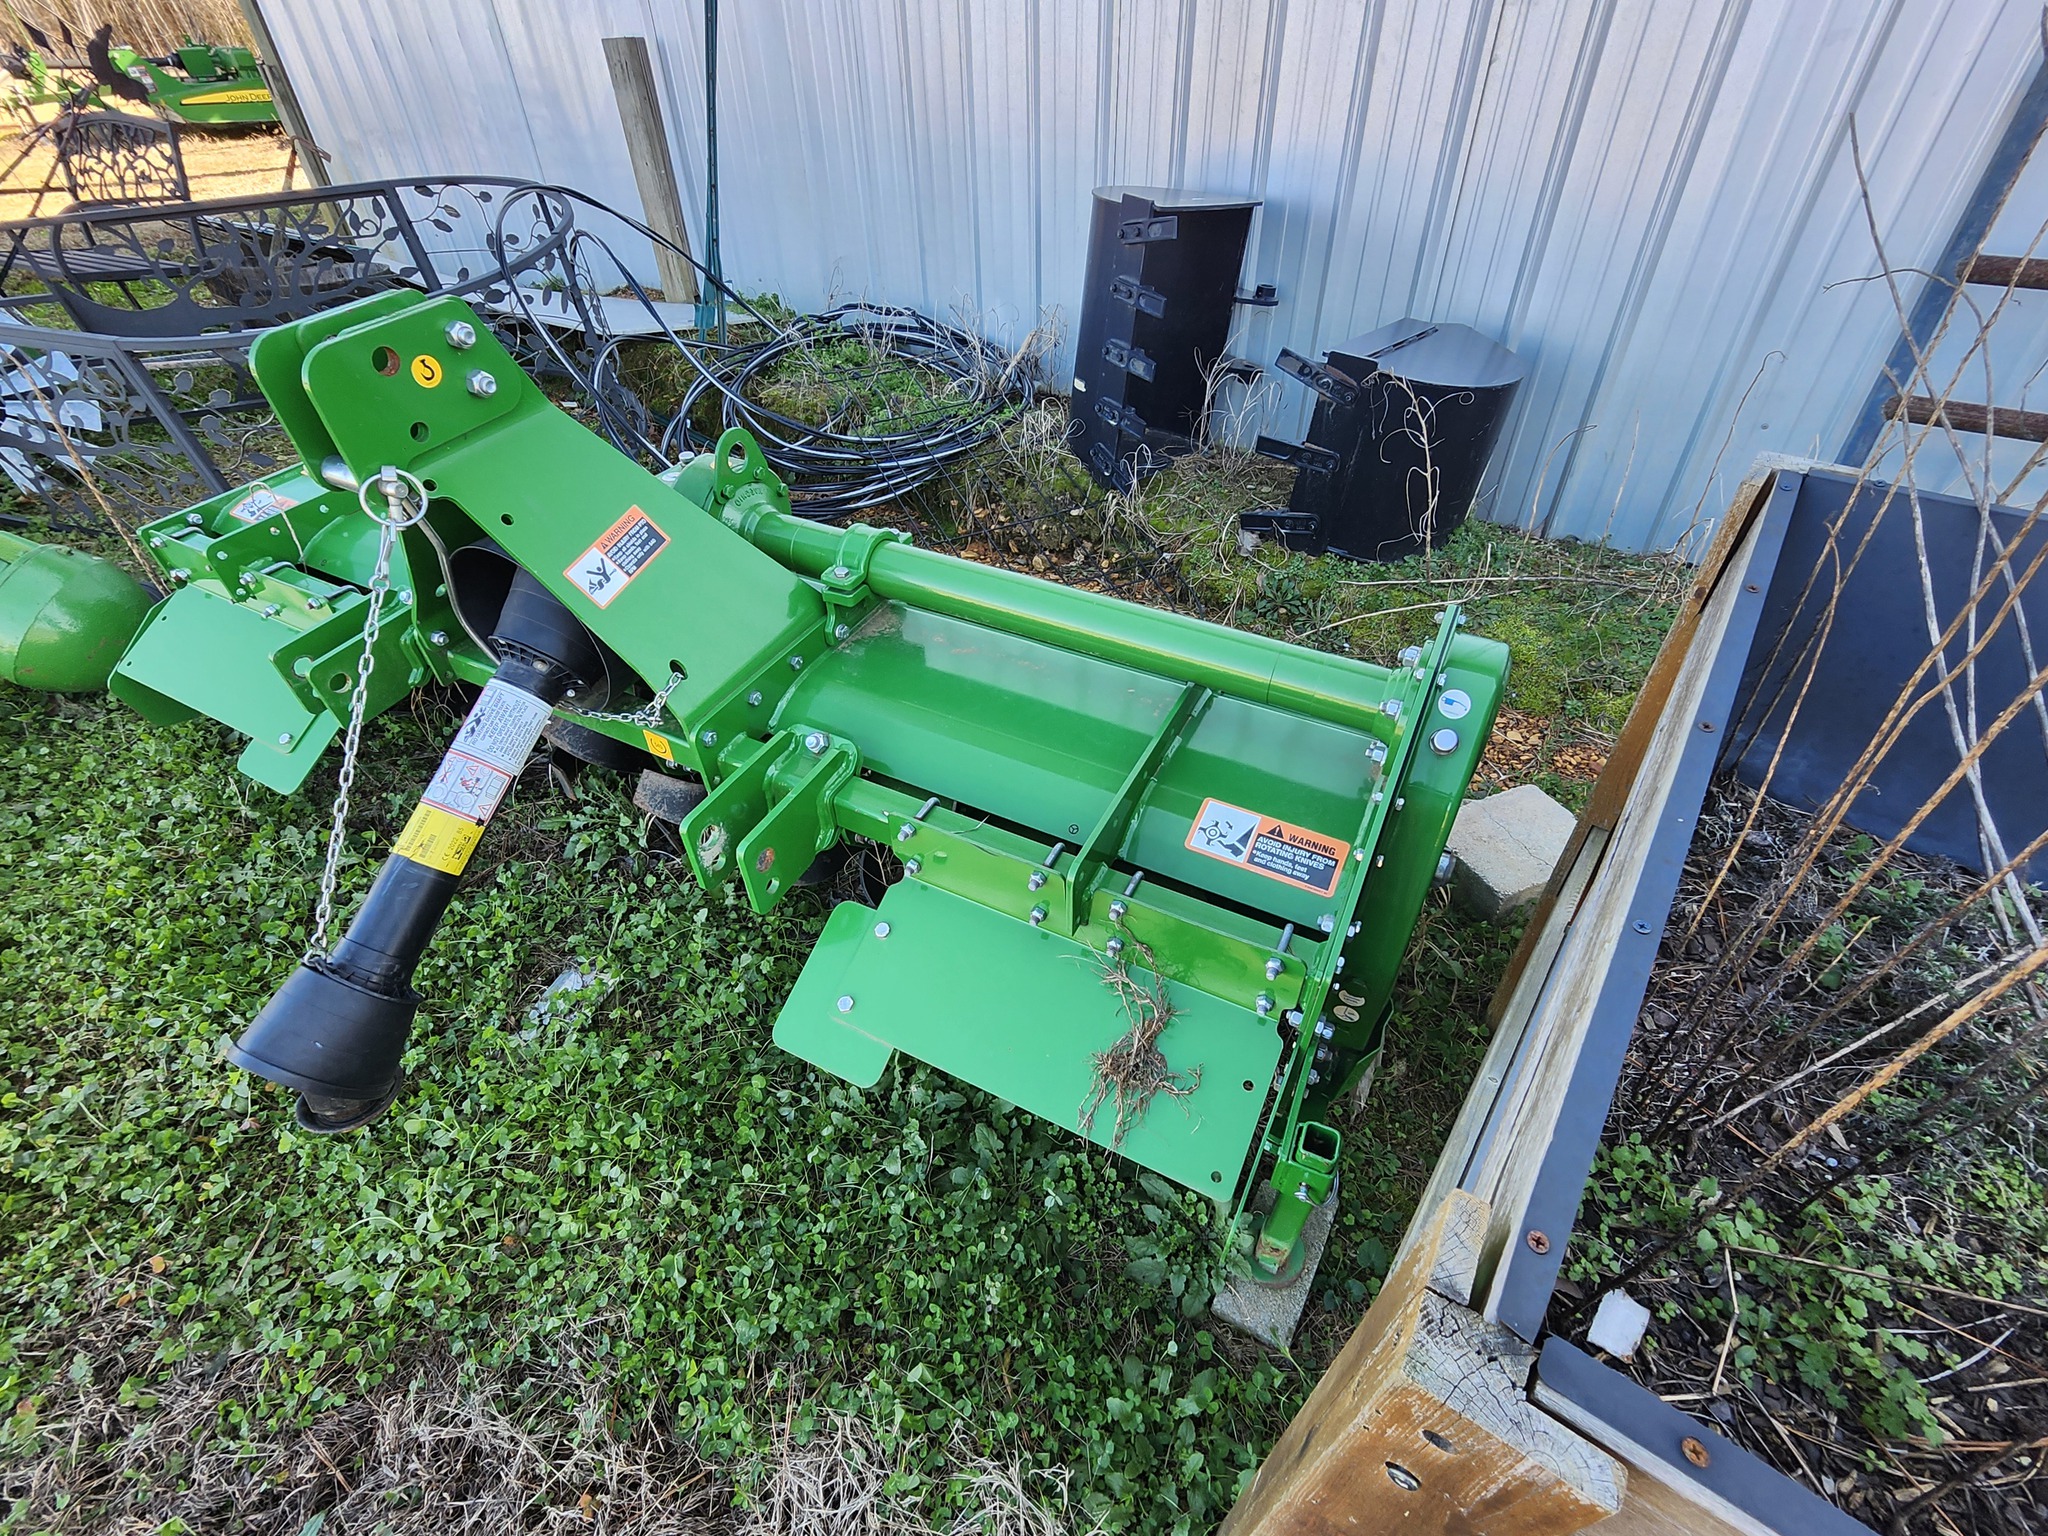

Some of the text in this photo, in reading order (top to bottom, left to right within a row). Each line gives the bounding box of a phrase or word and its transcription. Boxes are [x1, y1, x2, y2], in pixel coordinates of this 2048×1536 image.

[226, 93, 248, 101] JOHN
[605, 514, 635, 544] WARNING
[488, 722, 500, 739] KEEP
[1257, 836, 1335, 866] AVOID INJURY FROM
[1289, 833, 1336, 855] WARNING
[1255, 842, 1324, 870] ROTATING KNIVES
[1256, 851, 1307, 872] Keep hands, feet
[1254, 857, 1310, 880] and clothing away
